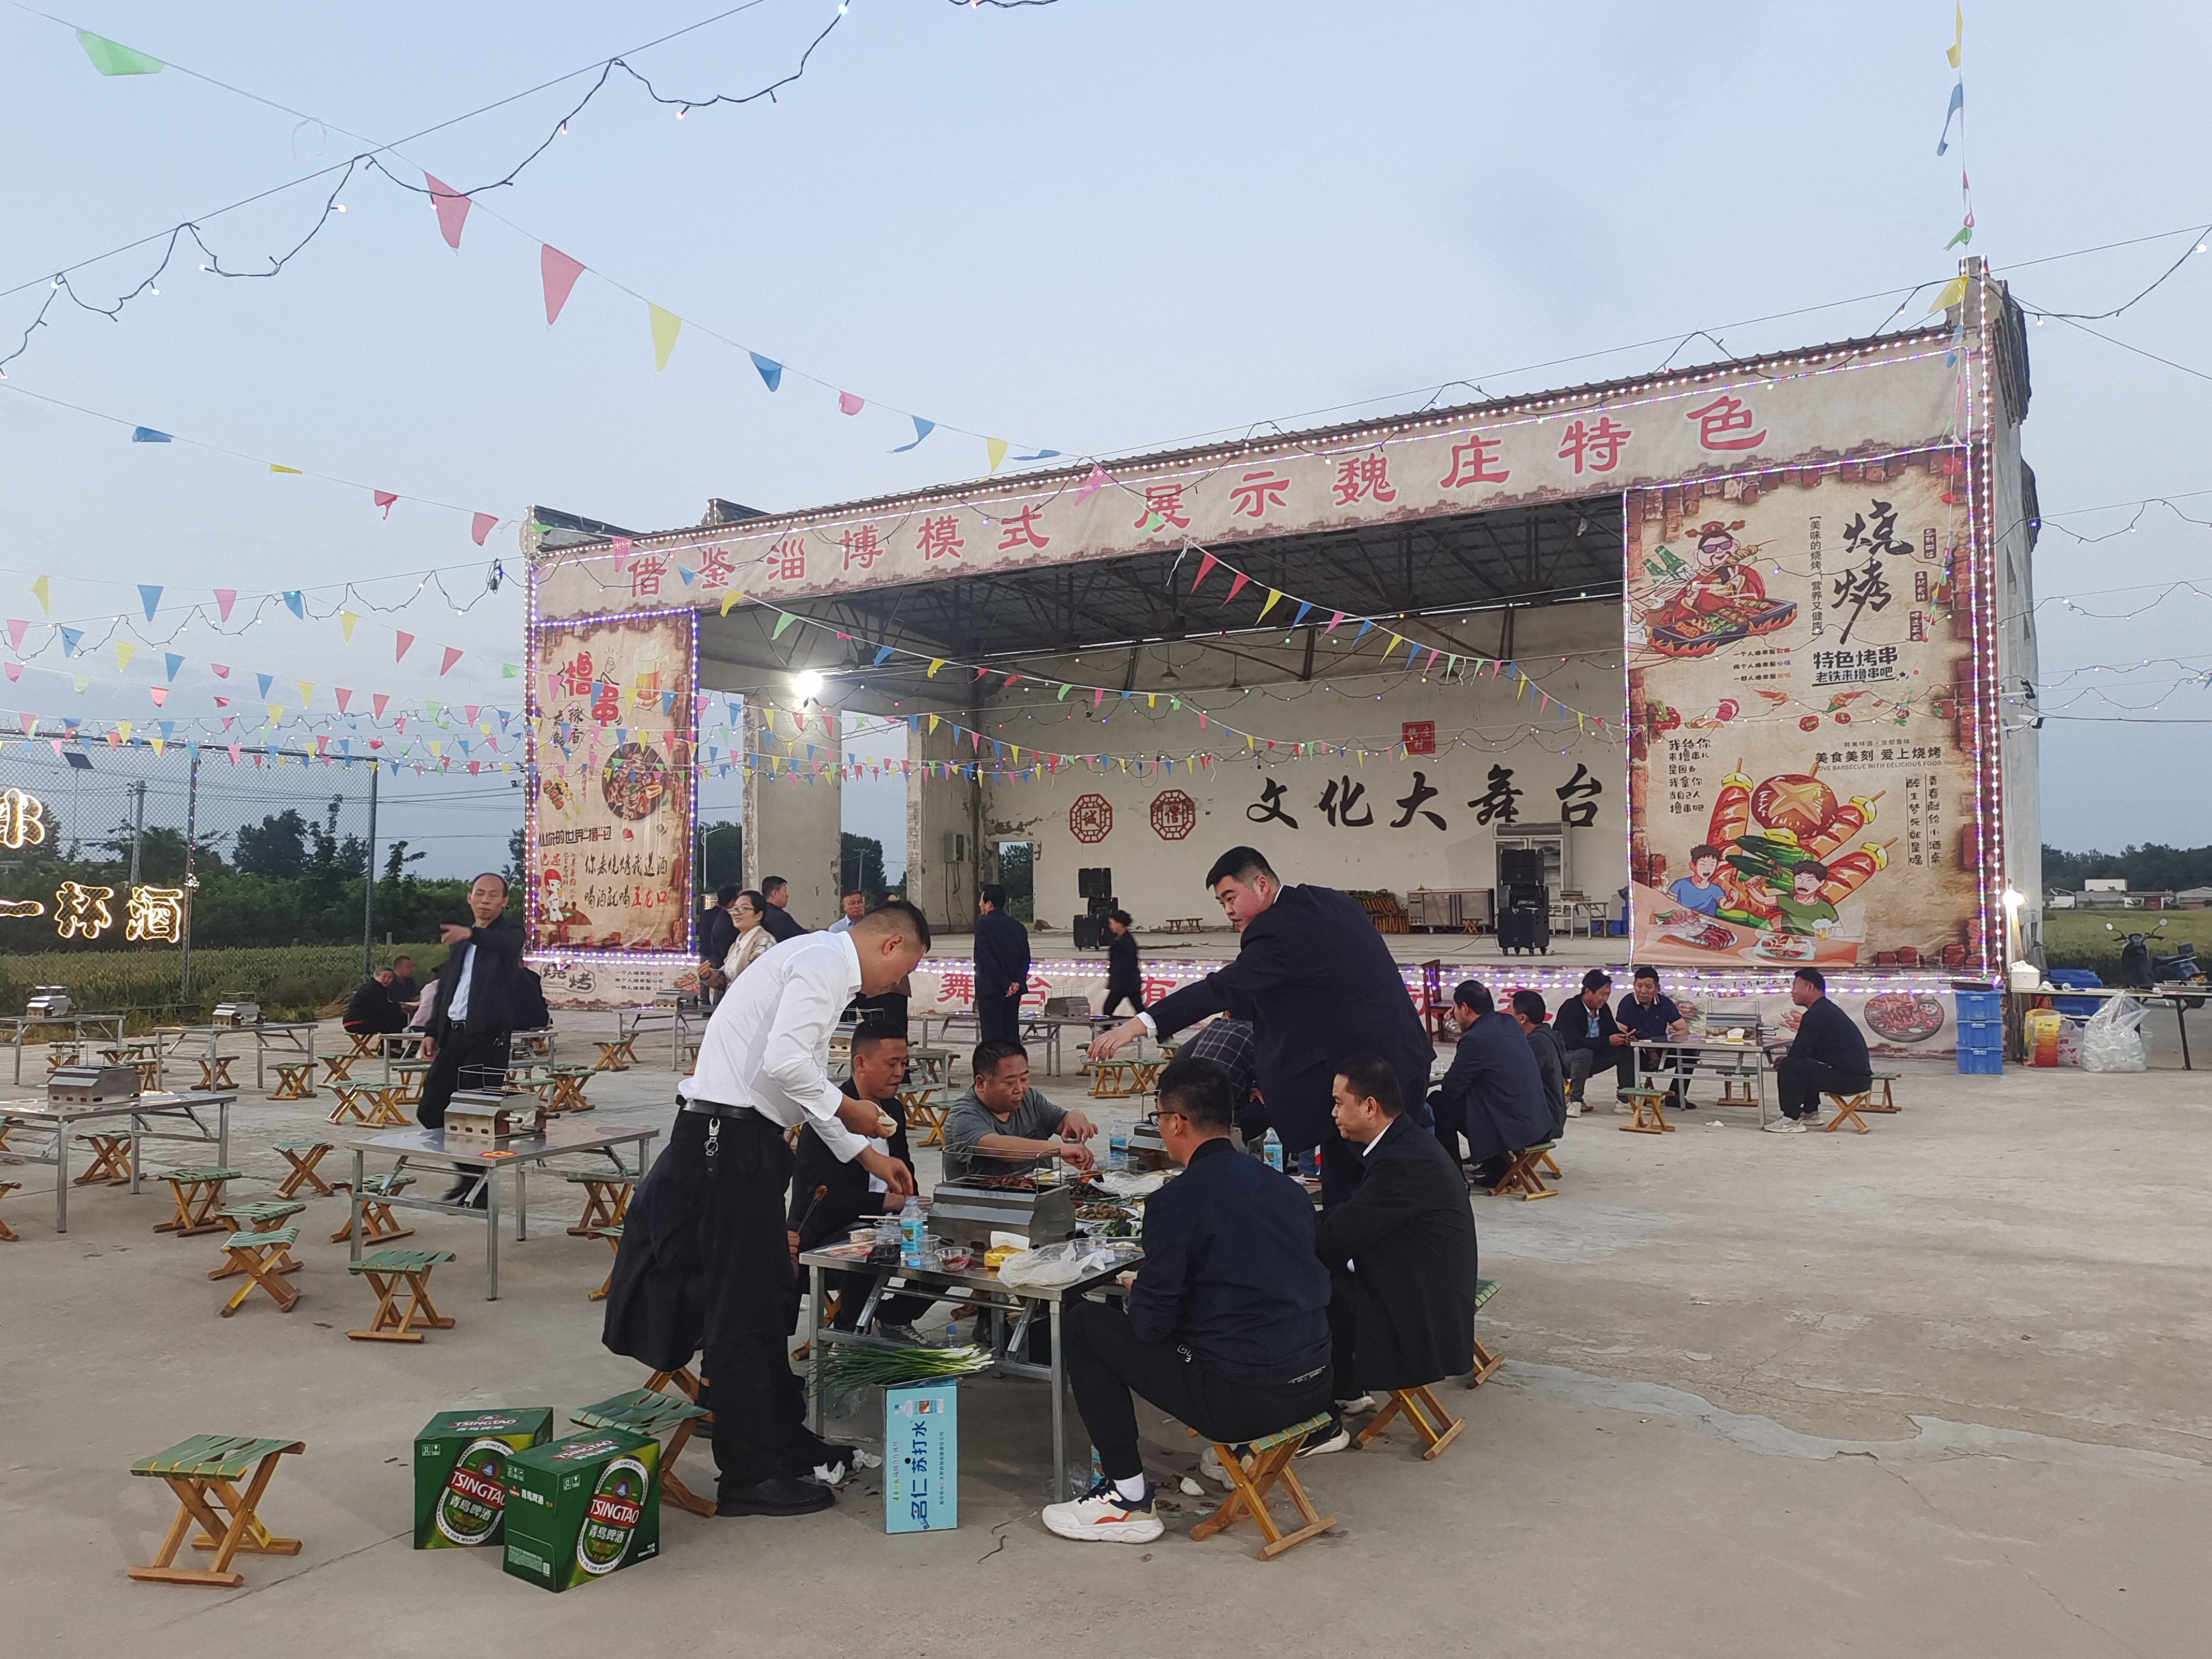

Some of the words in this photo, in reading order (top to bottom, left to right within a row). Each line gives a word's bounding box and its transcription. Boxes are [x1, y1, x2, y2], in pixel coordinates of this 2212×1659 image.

[1831, 498, 1914, 644] 烧烤
[1813, 646, 1898, 669] 特色烤串
[1815, 666, 1894, 682] 老铁来撸串吧
[564, 651, 619, 727] 撸串
[1669, 738, 1710, 751] 我给你
[1815, 749, 1874, 764] 美食美刻
[1880, 747, 1942, 761] 爱上烧烤
[1669, 764, 1695, 775] 是因为
[1669, 776, 1703, 787] 我拿你
[1246, 763, 1603, 831] 文化大舞台
[1669, 791, 1700, 800] 当自己人
[1164, 805, 1180, 824] 信
[1670, 801, 1704, 814] 撸串吧
[0, 881, 183, 943] 一杯酒
[543, 962, 592, 991] 烧烤
[554, 1440, 613, 1459] TSINGTAO
[911, 1420, 928, 1520] 名仁苏打水
[448, 1495, 493, 1521] 青岛啤酒
[589, 1499, 640, 1524] TSINGTAO
[588, 1525, 625, 1543] 青岛啤酒
